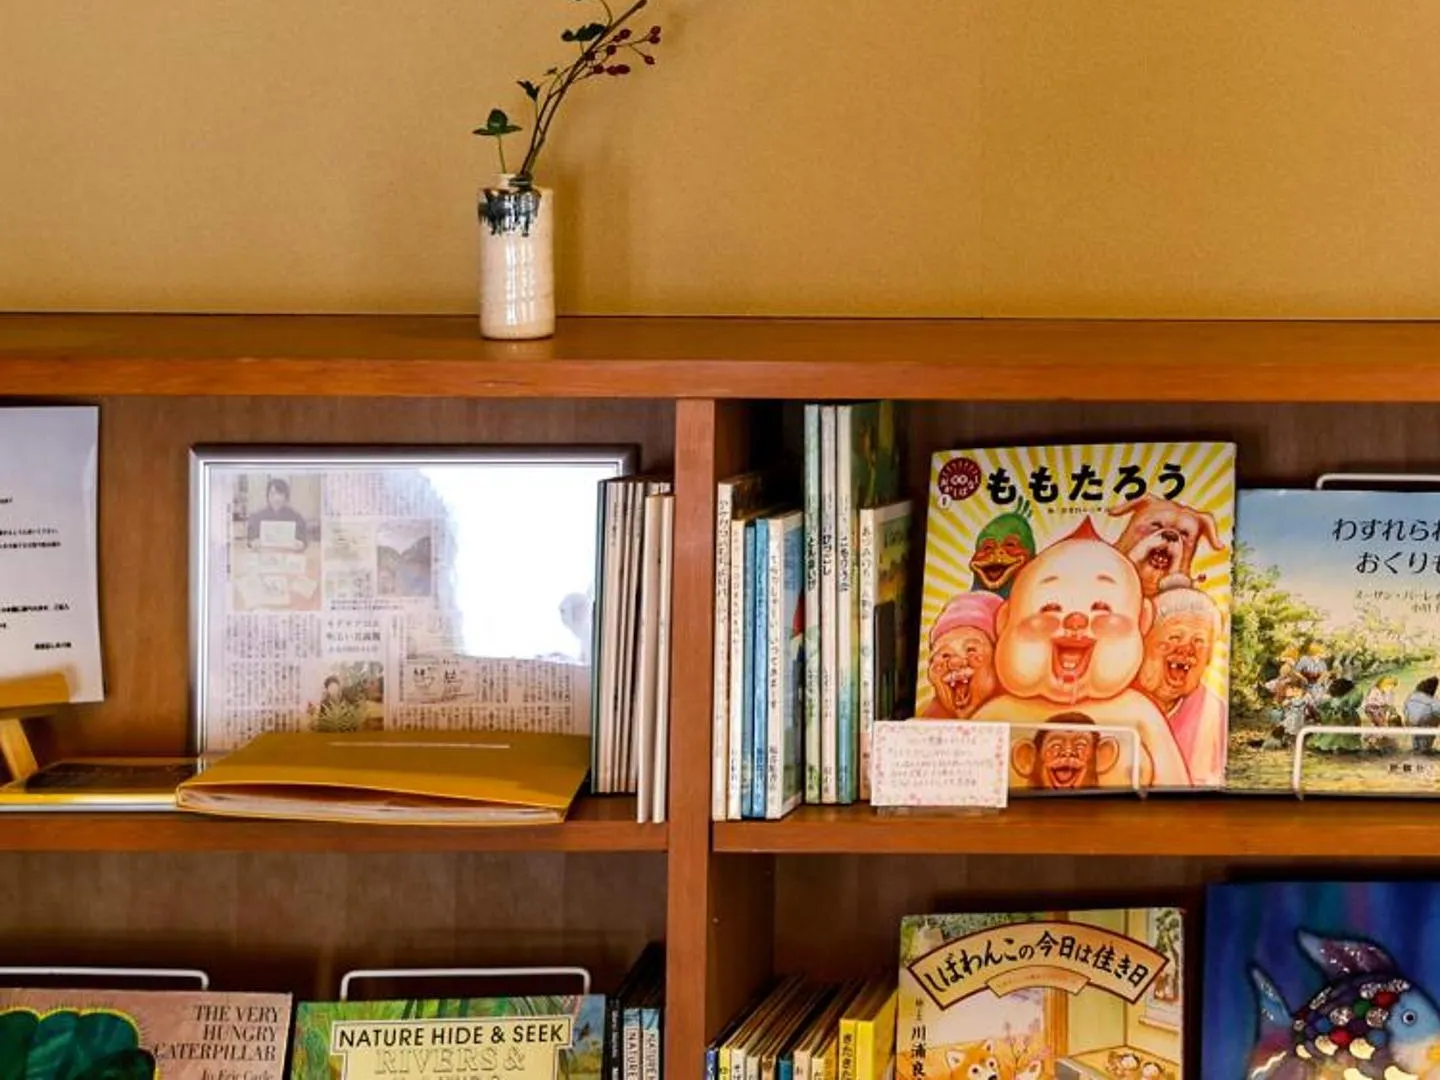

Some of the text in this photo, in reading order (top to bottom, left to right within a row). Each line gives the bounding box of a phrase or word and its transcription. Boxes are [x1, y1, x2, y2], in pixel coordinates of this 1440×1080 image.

[986, 462, 1186, 505] ももたろう
[195, 1005, 280, 1023] THE VERY
[203, 1023, 277, 1043] HUNGRY
[339, 1024, 564, 1047] NATURE HIDE & SEEK
[153, 1042, 277, 1061] CATERPILLAR
[374, 1047, 526, 1074] RIVERS &
